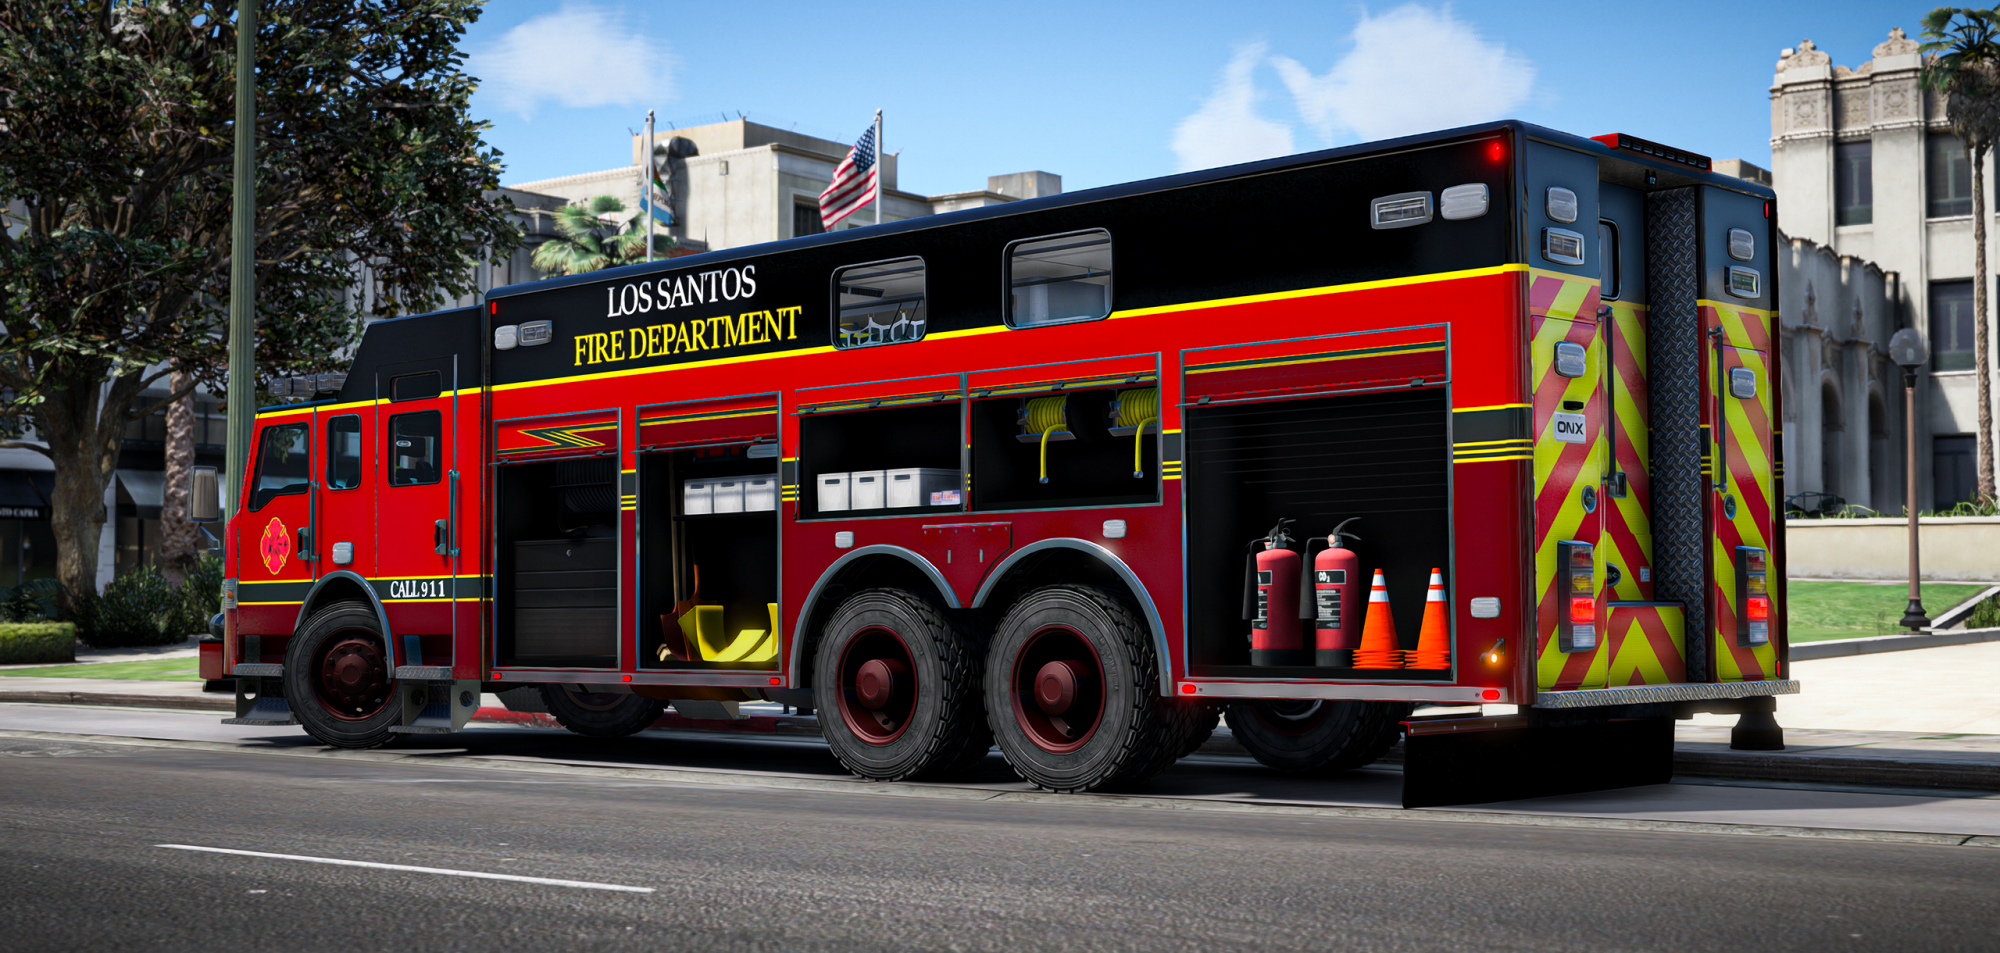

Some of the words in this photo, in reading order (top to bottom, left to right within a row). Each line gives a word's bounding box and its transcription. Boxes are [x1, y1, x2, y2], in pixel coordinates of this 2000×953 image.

[607, 281, 652, 318] LOS
[656, 265, 756, 310] SANTOS
[574, 329, 626, 366] FIRE
[629, 306, 802, 359] DEPARTMENT
[1557, 421, 1584, 435] ONX
[390, 580, 420, 598] CALL
[421, 580, 445, 597] 911
